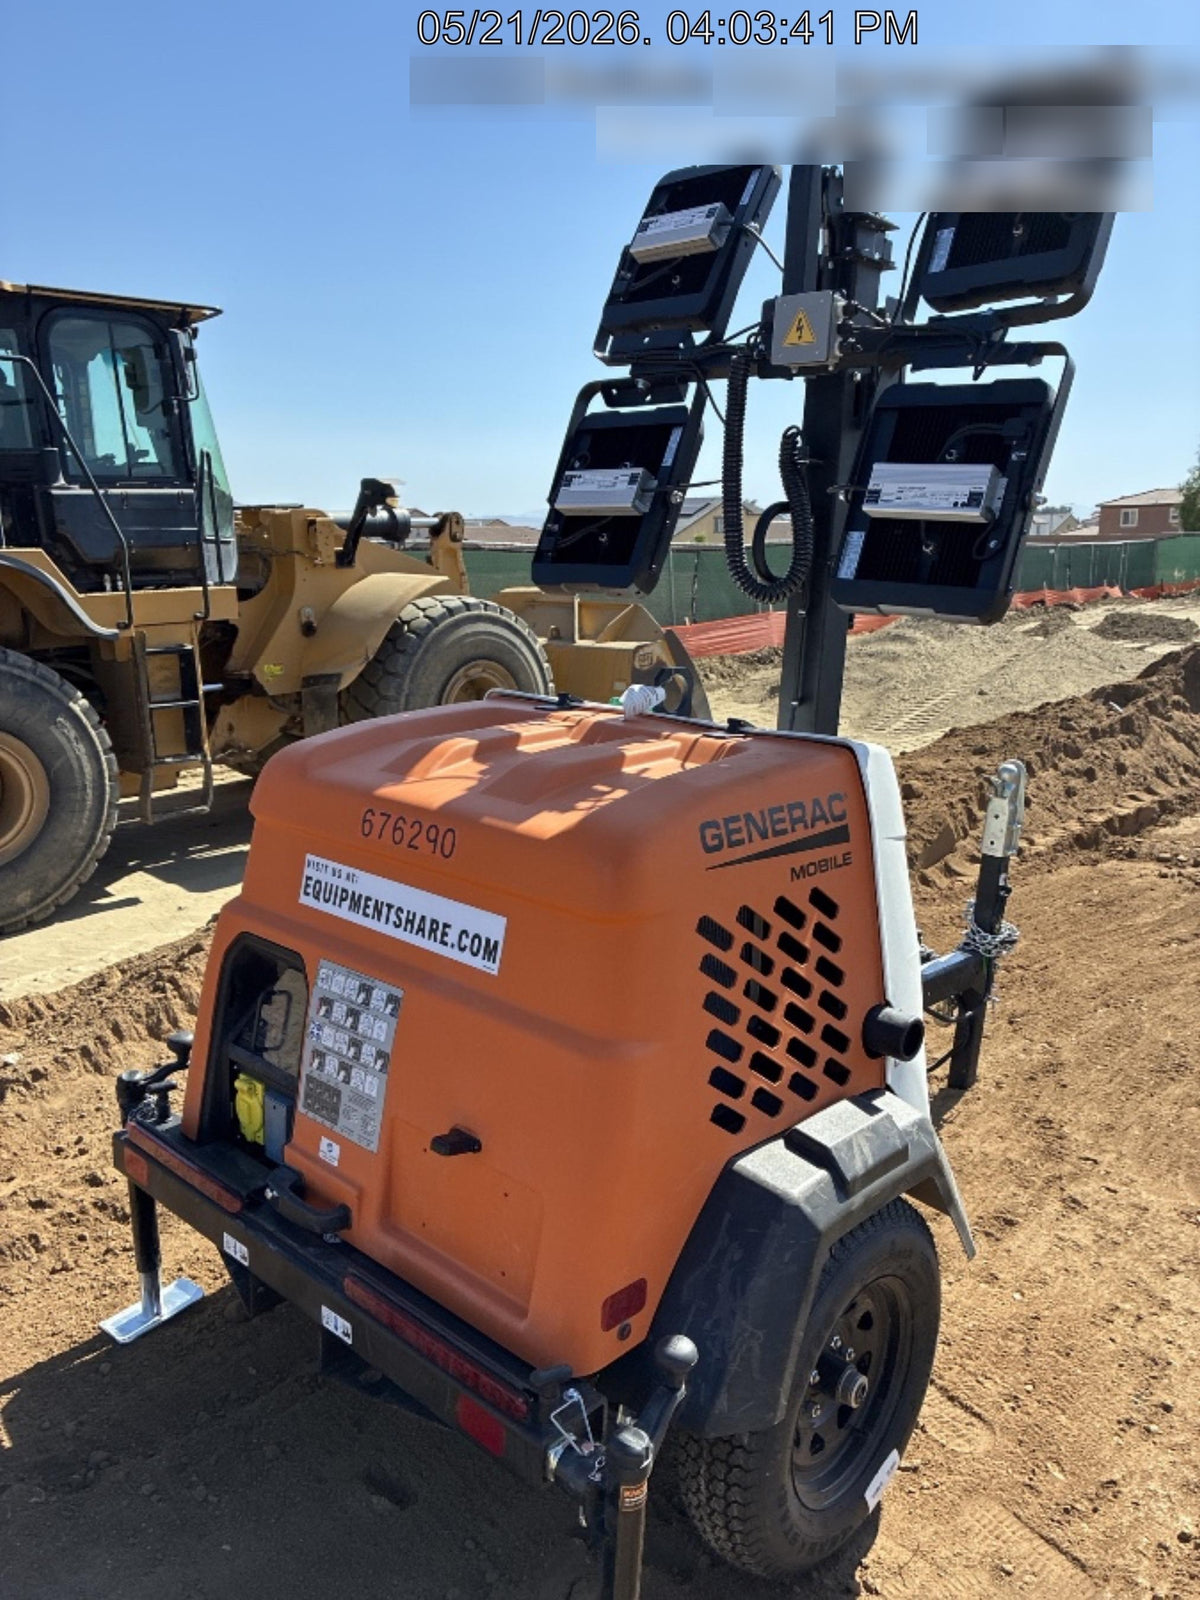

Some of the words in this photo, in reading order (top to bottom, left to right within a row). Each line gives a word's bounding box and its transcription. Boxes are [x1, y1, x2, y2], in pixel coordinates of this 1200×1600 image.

[361, 808, 457, 860] 676290
[699, 792, 848, 854] GENERAC
[307, 858, 329, 874] VISIT
[790, 851, 853, 882] MOBILE
[303, 875, 499, 964] EQUIPMENTSHARE.COM
